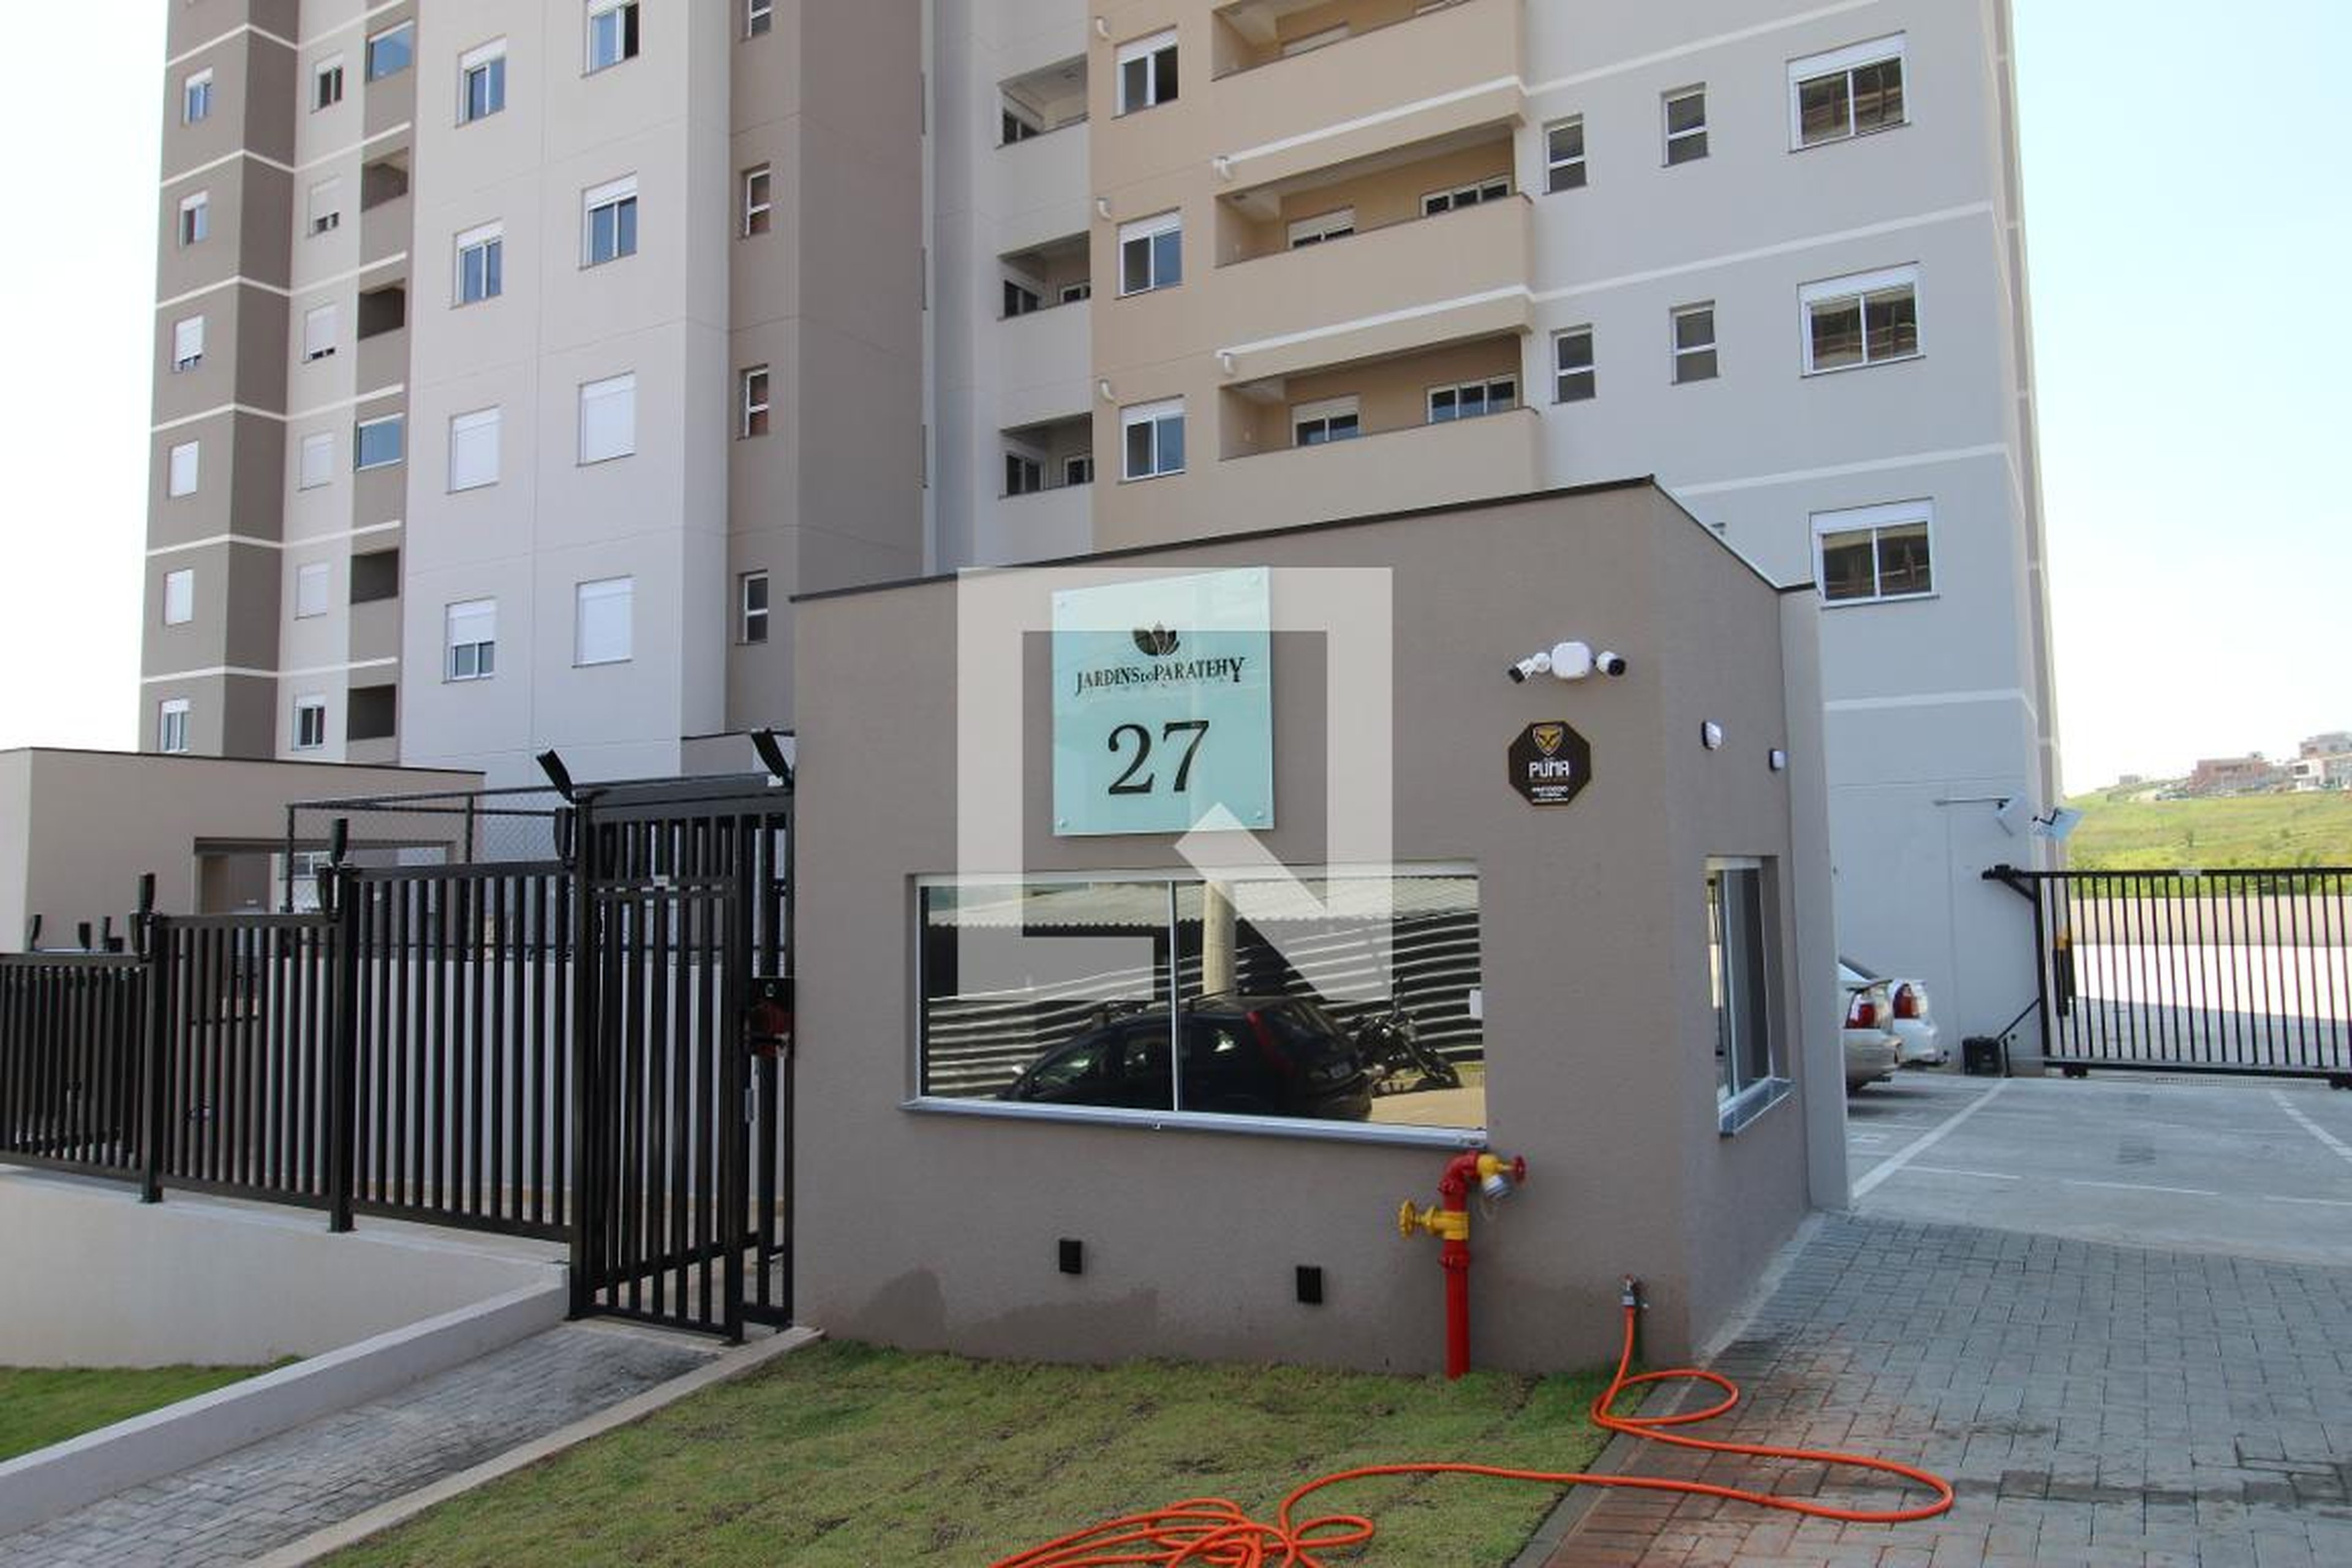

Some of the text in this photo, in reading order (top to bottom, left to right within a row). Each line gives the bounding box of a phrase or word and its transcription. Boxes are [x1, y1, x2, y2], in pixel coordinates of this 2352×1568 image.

[1075, 666, 1140, 695] JARDINS
[1107, 720, 1210, 796] 27
[1528, 760, 1569, 778] PUMA
